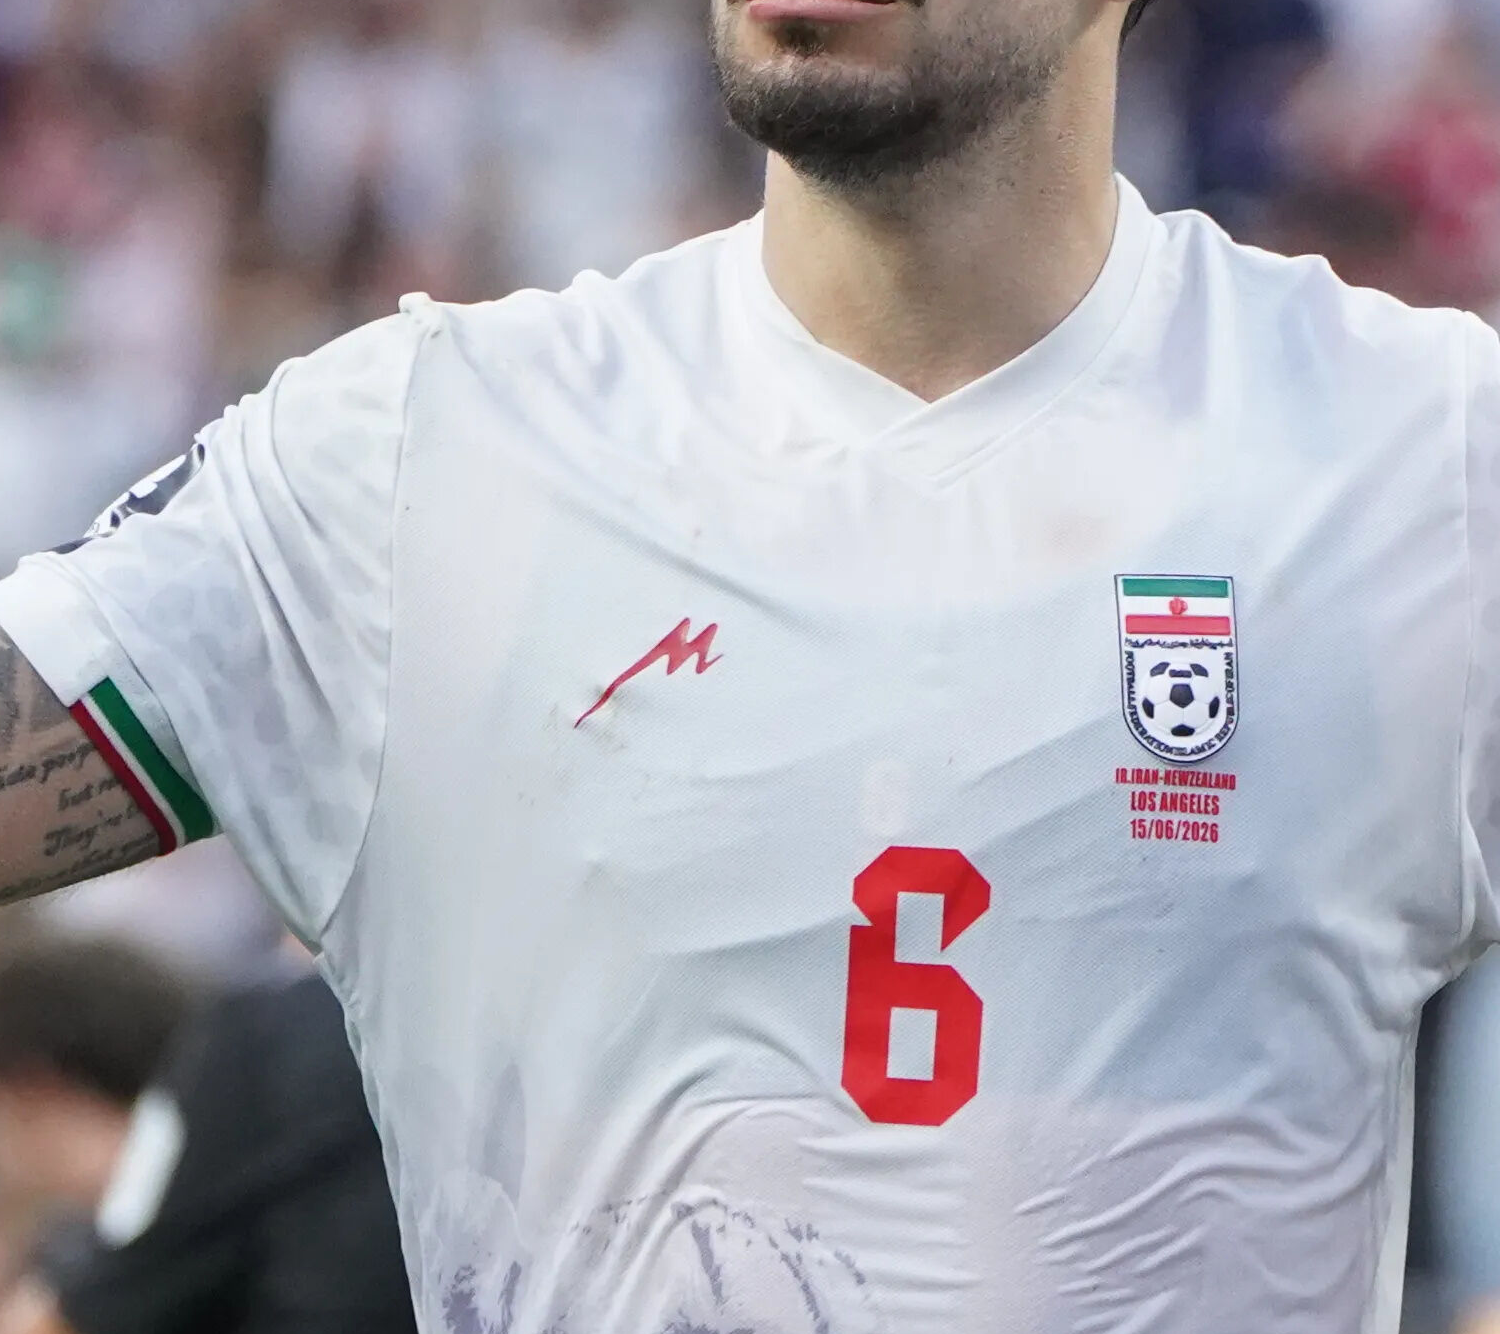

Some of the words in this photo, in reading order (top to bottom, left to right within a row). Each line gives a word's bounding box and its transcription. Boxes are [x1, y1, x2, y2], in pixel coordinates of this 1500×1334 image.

[1130, 791, 1157, 812] LOS
[1159, 792, 1220, 816] ANGELES
[1130, 818, 1219, 844] 15/06/2026
[840, 845, 992, 1127] 6
